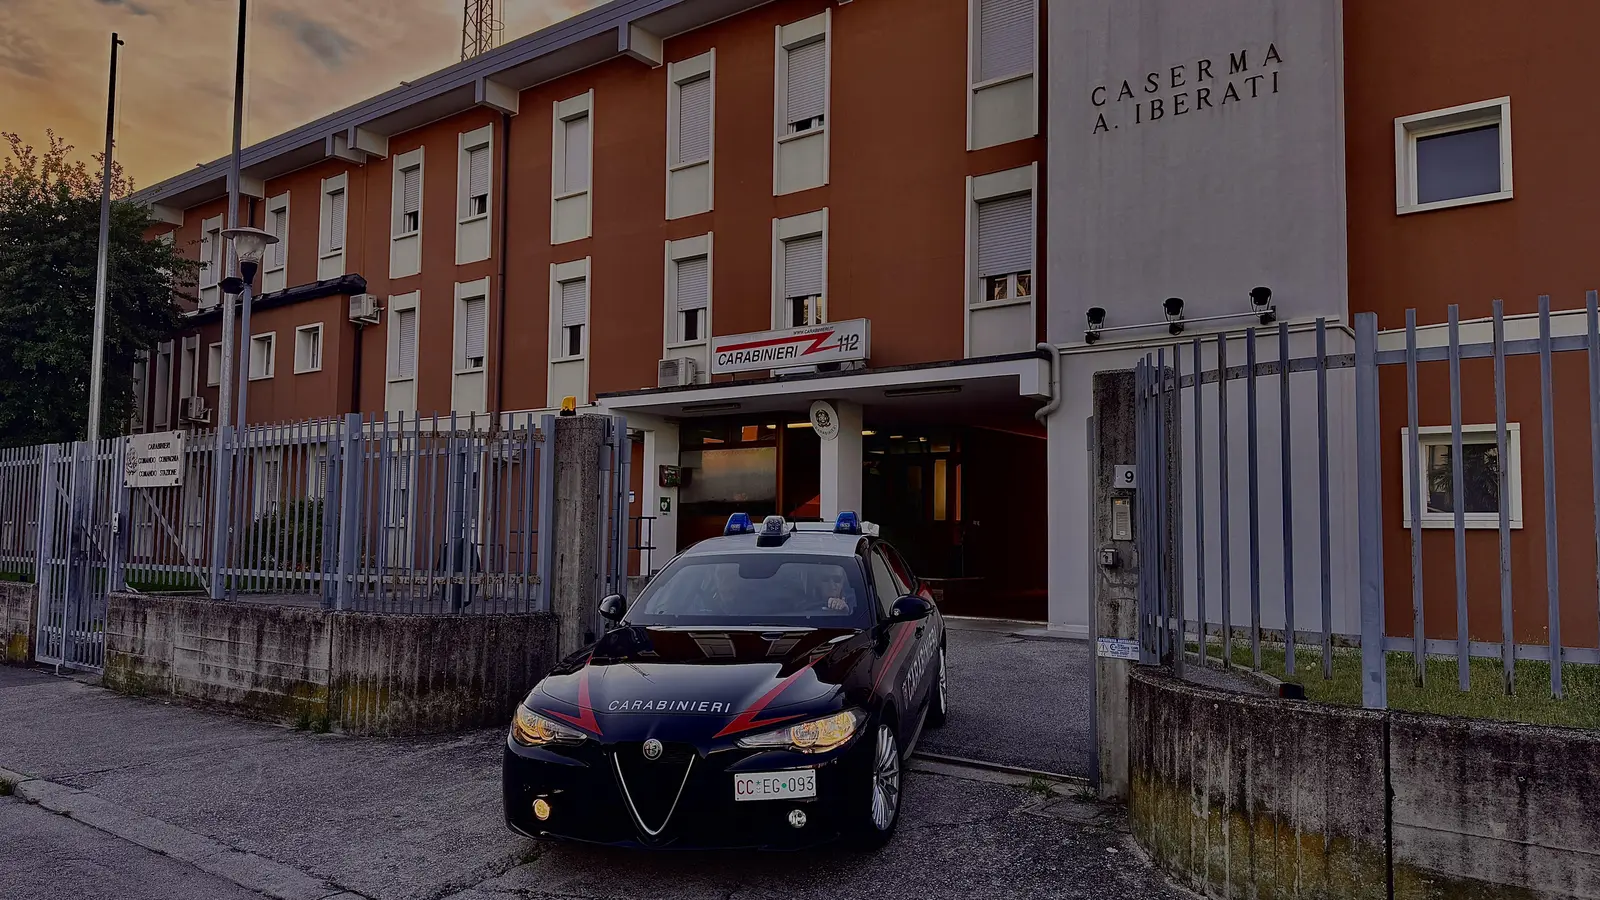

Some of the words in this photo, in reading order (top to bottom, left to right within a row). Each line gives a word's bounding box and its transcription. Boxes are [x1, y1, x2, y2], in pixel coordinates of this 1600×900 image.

[1091, 43, 1283, 106] CASERMA
[1093, 113, 1118, 134] A.
[1136, 71, 1279, 124] IBERATI
[718, 345, 798, 366] CARABINIERI
[837, 334, 859, 353] 112
[1125, 471, 1134, 483] 9
[608, 700, 731, 713] CARABINIERI
